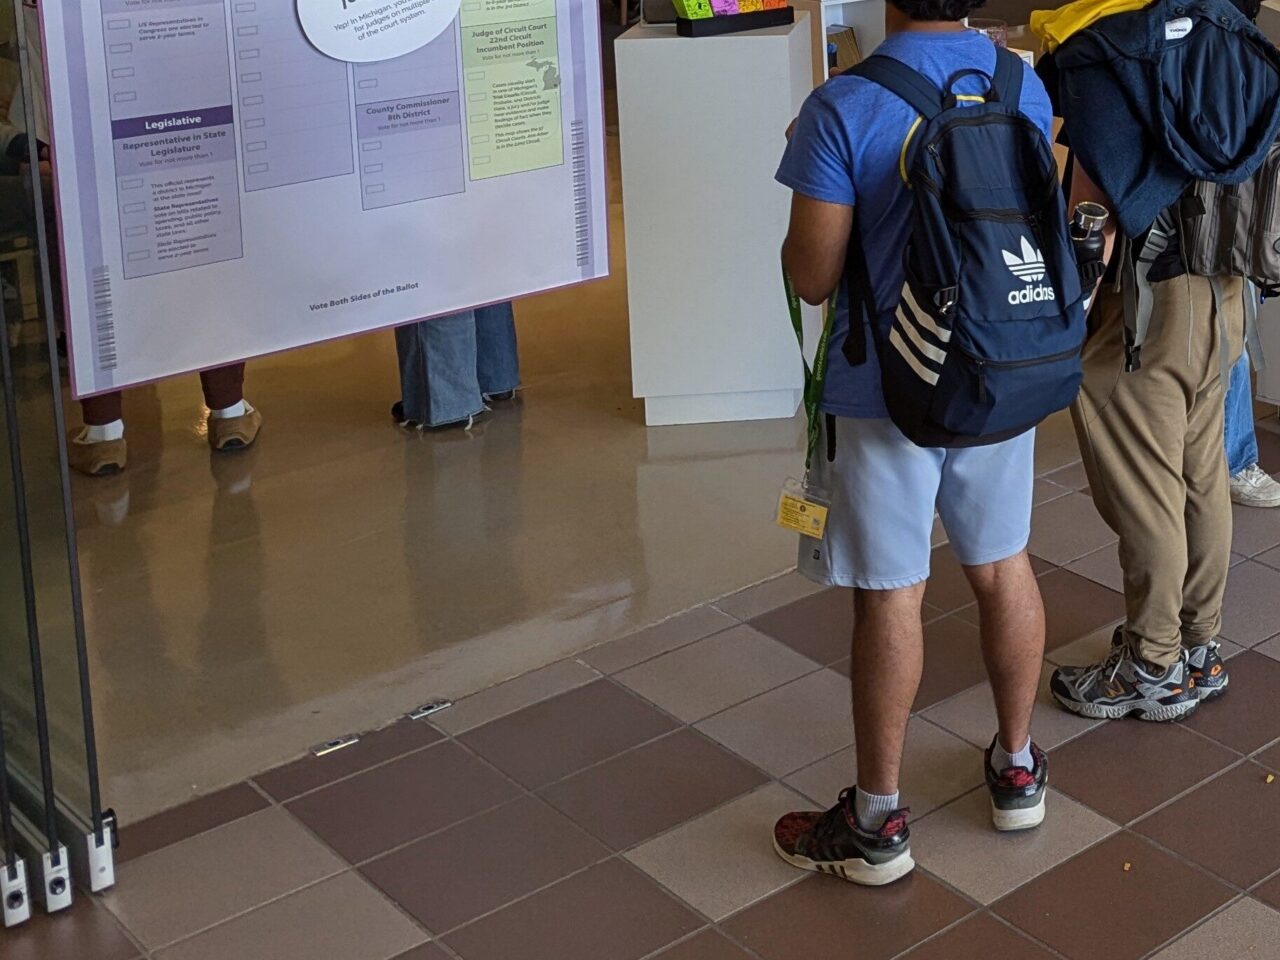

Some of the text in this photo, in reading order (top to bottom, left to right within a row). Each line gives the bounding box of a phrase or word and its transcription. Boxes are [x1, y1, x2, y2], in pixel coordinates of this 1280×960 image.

[333, 20, 350, 31] Yep!
[358, 4, 392, 22] Michigan,
[365, 15, 391, 30] judges
[367, 29, 378, 38] the
[380, 20, 400, 32] court
[399, 9, 425, 24] system.
[366, 98, 450, 116] County Commissioner
[403, 108, 431, 118] District
[144, 115, 202, 130] Legislative
[122, 134, 191, 151] Representative
[204, 131, 226, 139] State
[150, 144, 201, 157] Legislature
[309, 302, 328, 312] Vote
[329, 298, 349, 308] Both
[350, 292, 372, 303] Sides
[382, 287, 395, 296] the
[396, 282, 419, 293] Ballot
[1007, 283, 1055, 305] adidas
